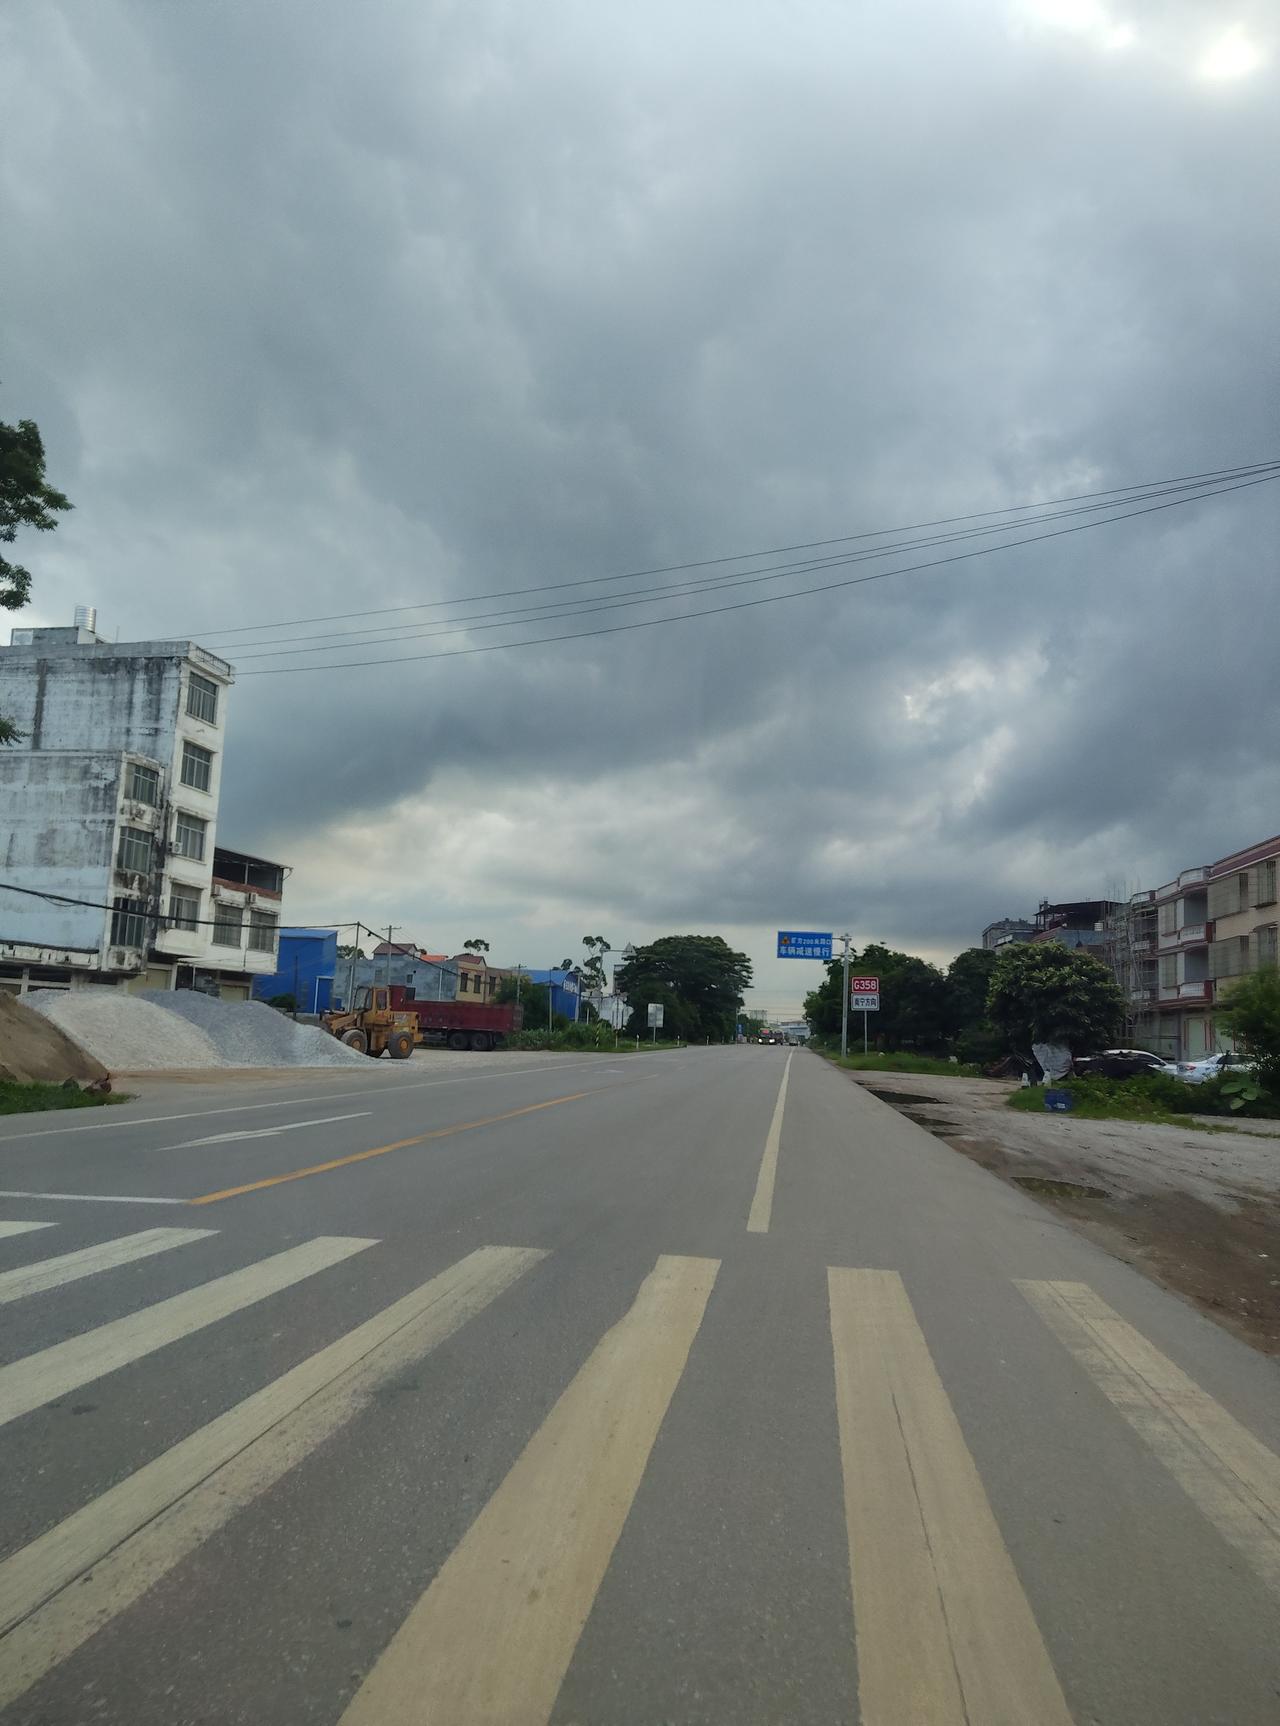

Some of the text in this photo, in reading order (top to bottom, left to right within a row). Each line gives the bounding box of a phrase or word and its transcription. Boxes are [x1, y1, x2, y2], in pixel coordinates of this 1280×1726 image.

[780, 946, 830, 957] 车辆减速慢行
[854, 980, 876, 990] G358
[855, 998, 876, 1007] 南宁方向
